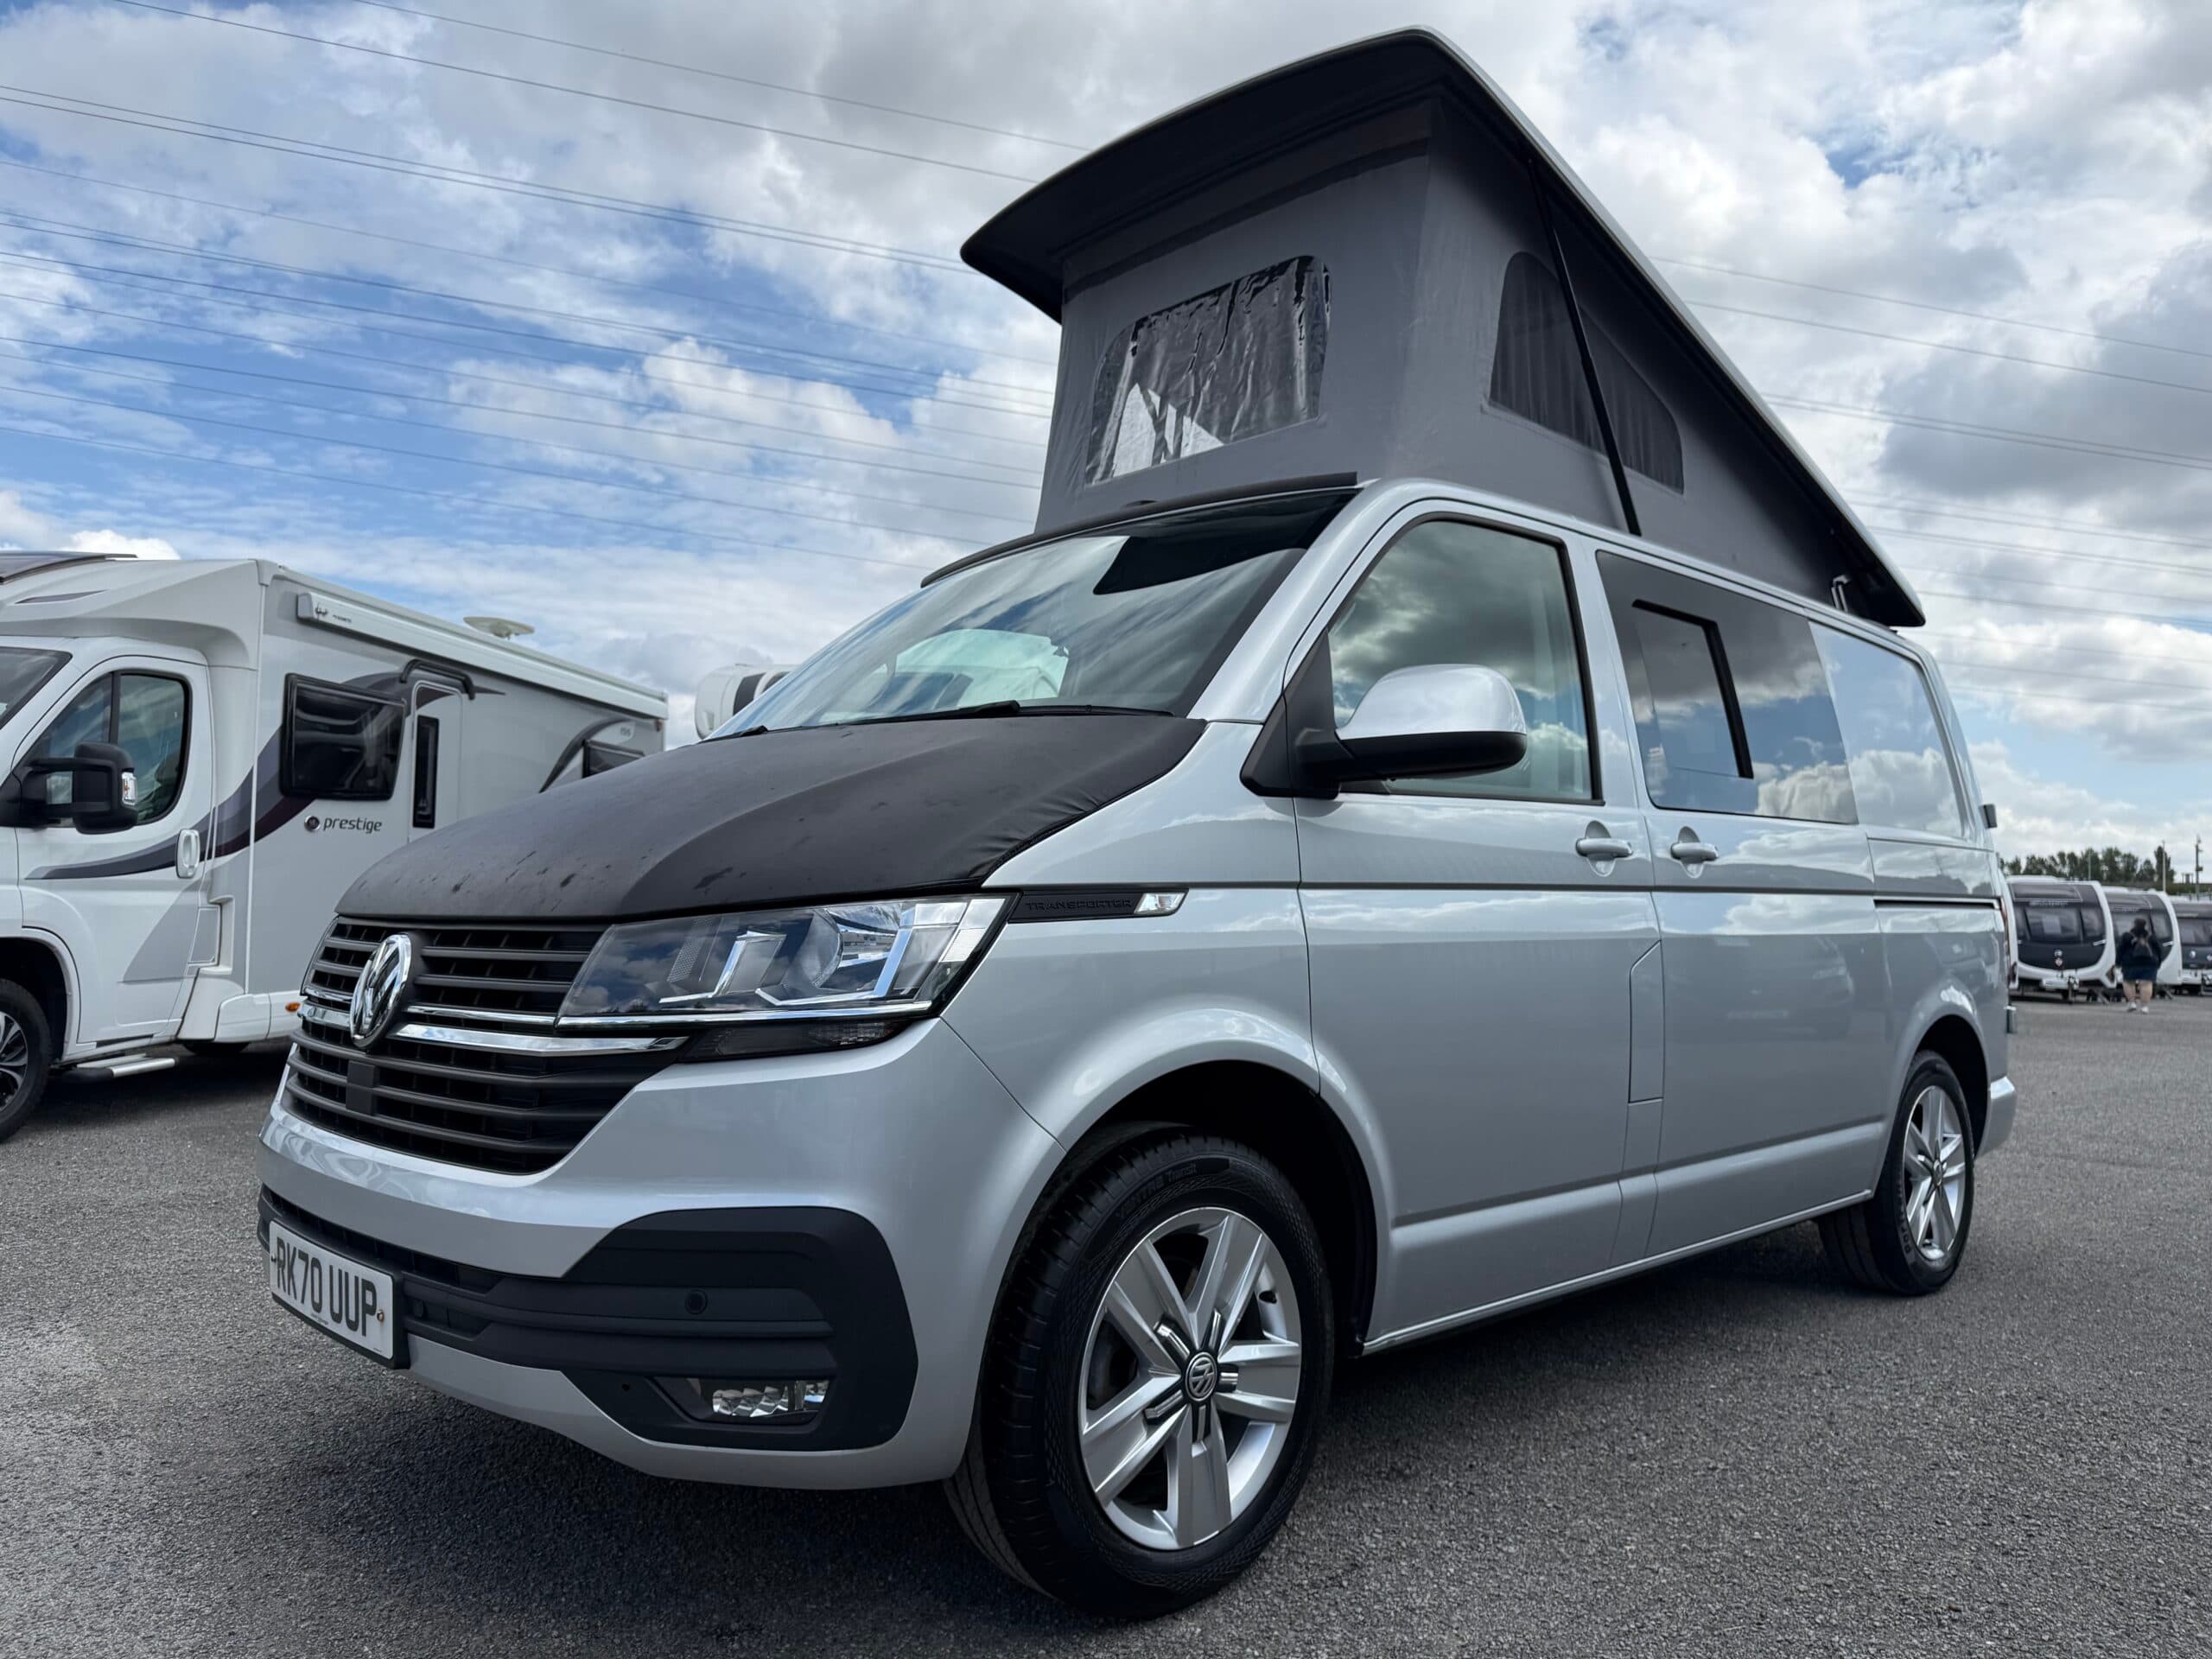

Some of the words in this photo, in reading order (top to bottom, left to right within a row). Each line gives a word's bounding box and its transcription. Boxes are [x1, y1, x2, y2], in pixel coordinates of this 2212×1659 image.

[323, 817, 382, 834] prestige
[1026, 899, 1132, 912] TRANSPORTER
[276, 1236, 322, 1313] RK70
[329, 1265, 377, 1337] UUP
